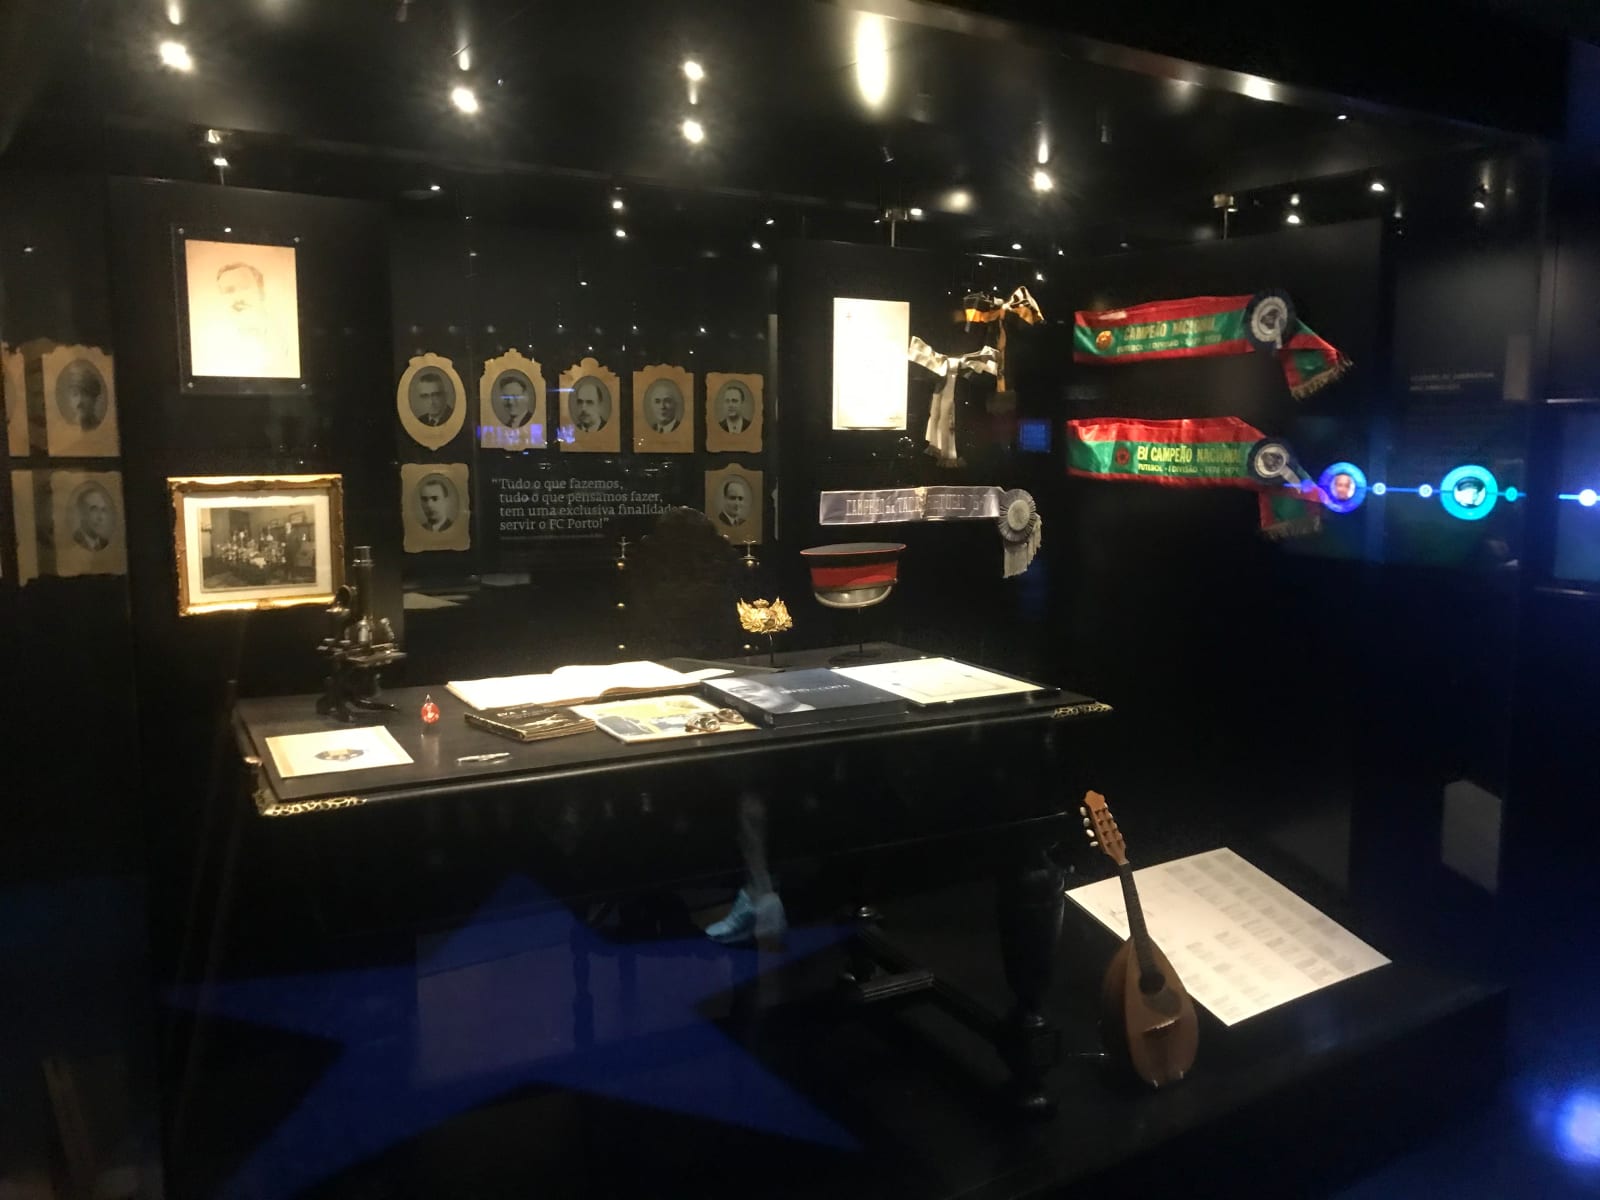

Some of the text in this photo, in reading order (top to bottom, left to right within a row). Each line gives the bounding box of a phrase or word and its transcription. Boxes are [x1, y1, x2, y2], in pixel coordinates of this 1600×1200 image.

[1137, 445, 1150, 460] BI
[1151, 444, 1193, 463] CAMPEÃO
[533, 481, 541, 489] o
[544, 480, 566, 491] que
[570, 478, 623, 490] fazemos,
[500, 491, 663, 505] tudo o que pensamos fazer,
[500, 506, 525, 517] tem
[528, 507, 556, 517] uma
[559, 505, 615, 517] exclusiva
[500, 519, 536, 531] servir
[538, 521, 546, 530] o
[549, 519, 565, 530] FC
